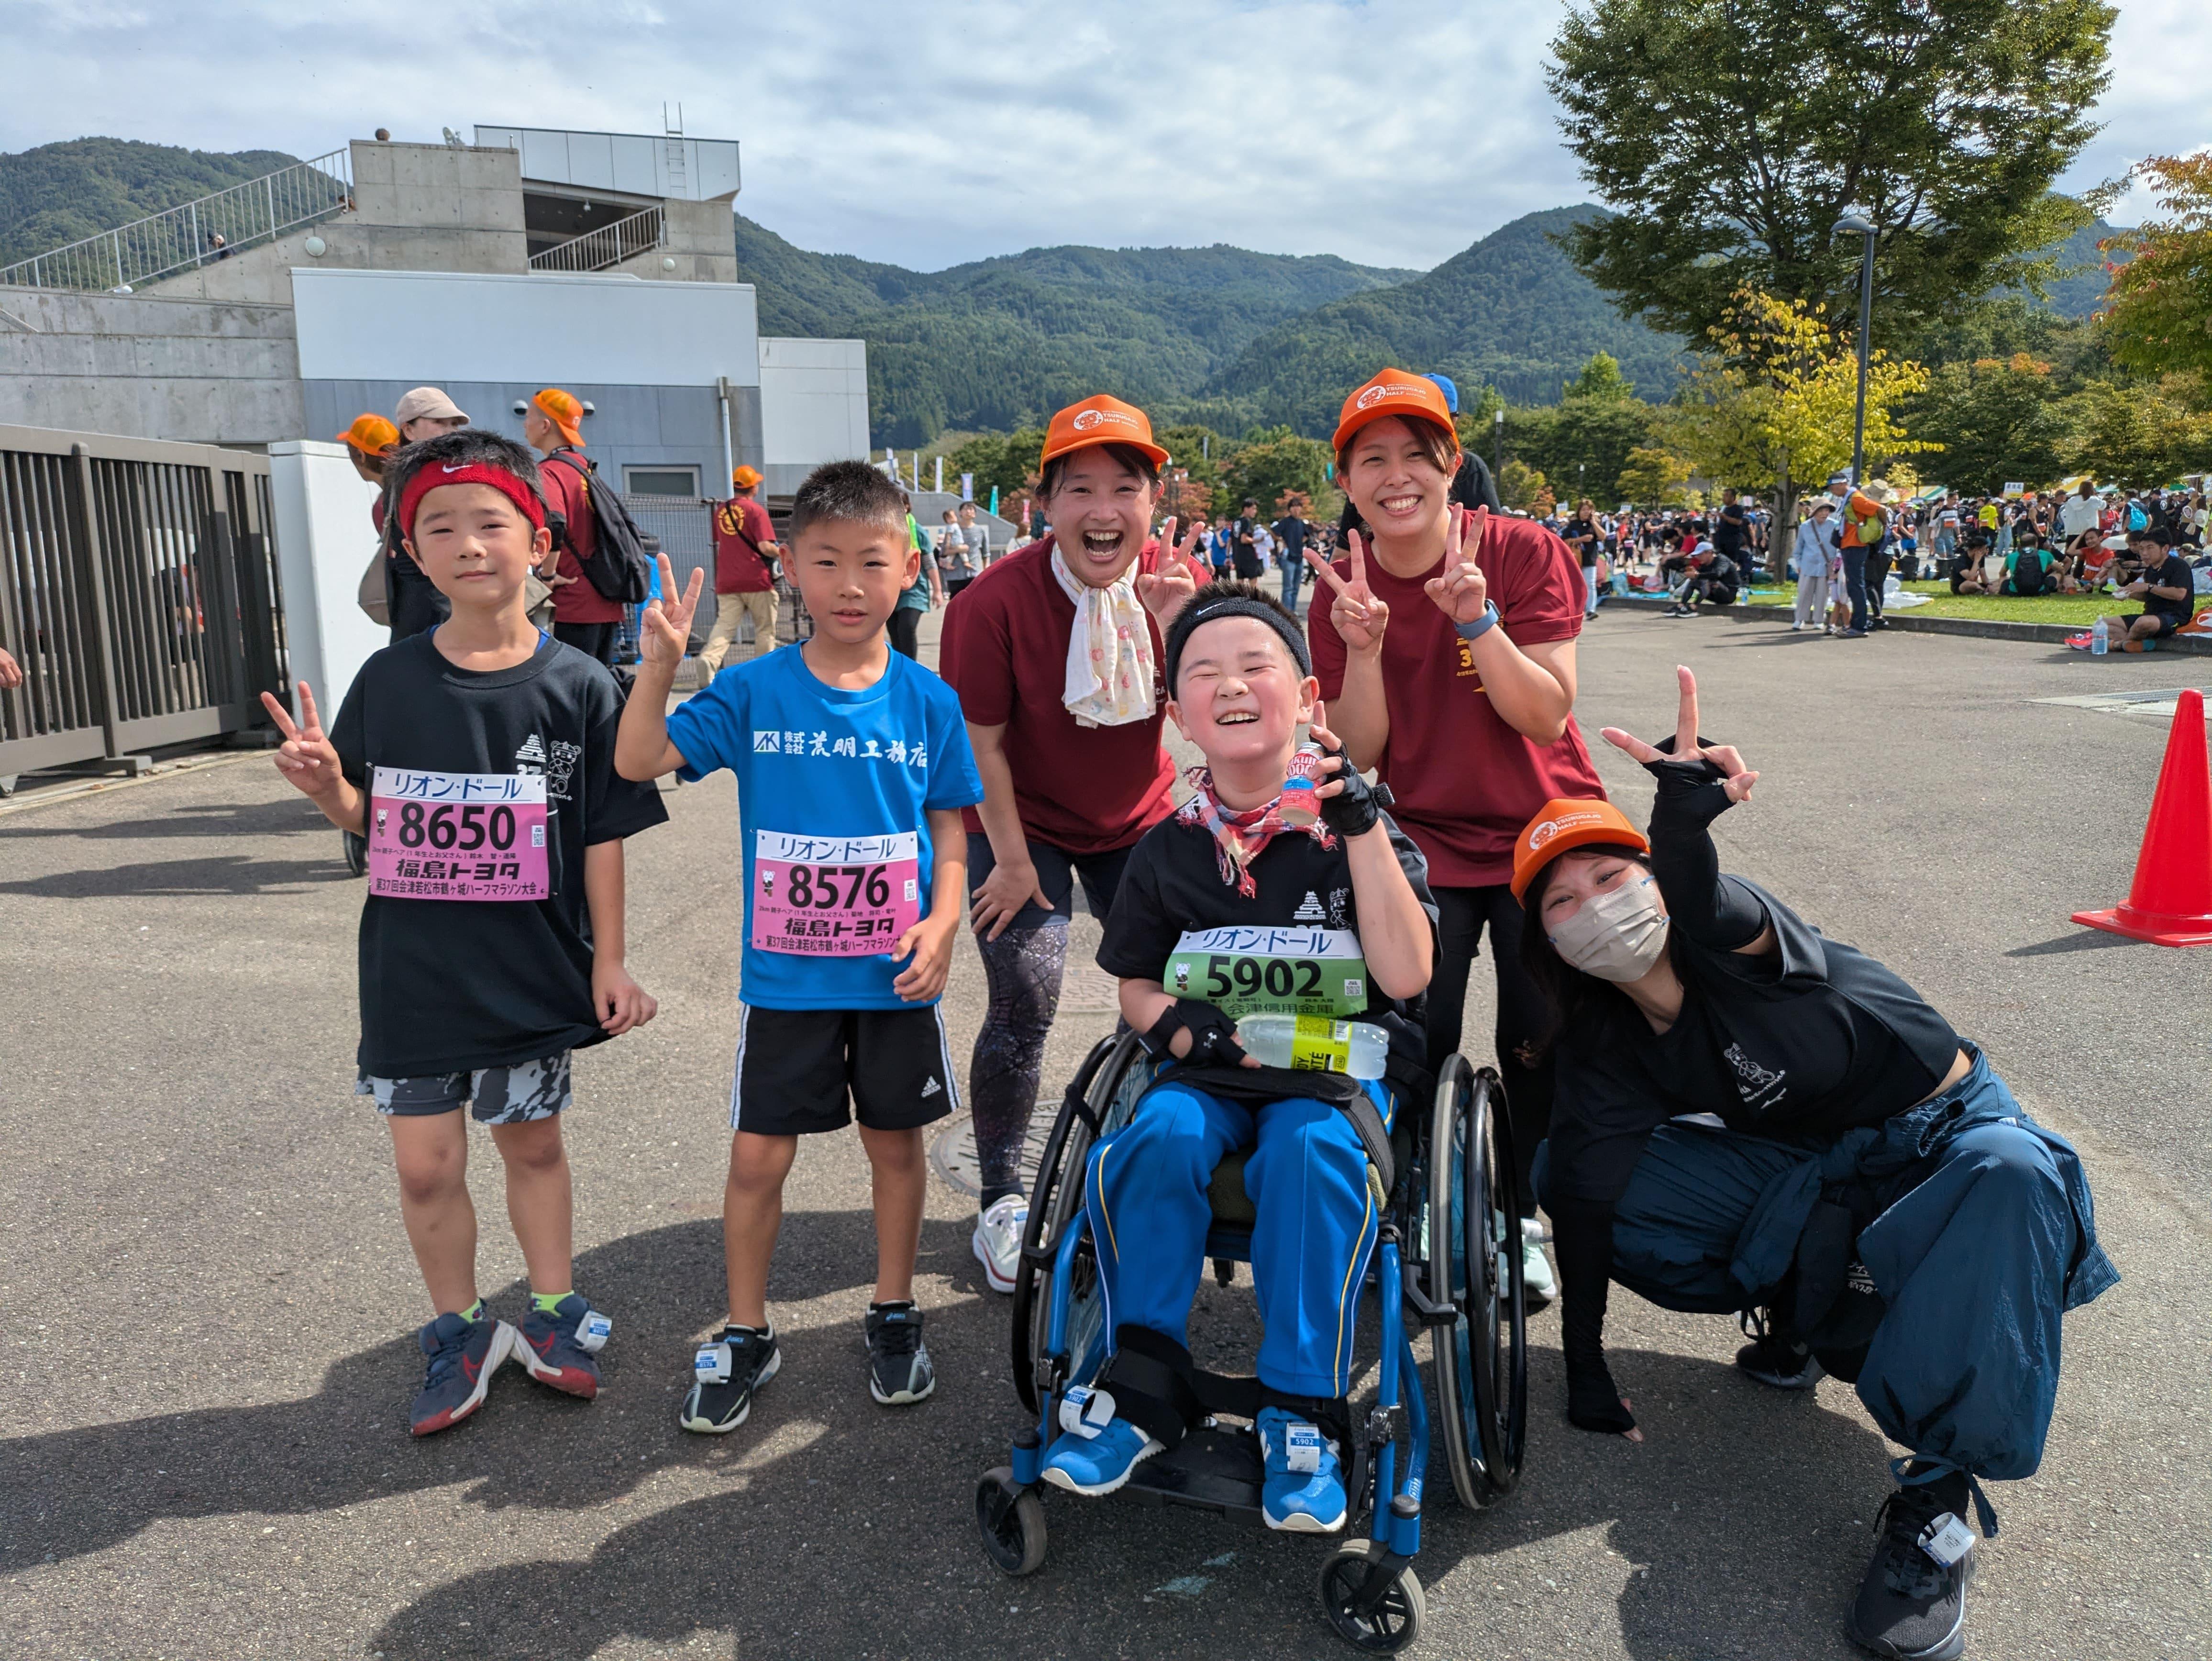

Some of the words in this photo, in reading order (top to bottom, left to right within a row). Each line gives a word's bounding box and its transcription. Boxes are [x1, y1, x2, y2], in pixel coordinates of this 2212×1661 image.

[395, 773, 523, 799] リオン・ドール
[399, 802, 516, 851] 8650
[781, 838, 896, 861] リオン・ドール
[396, 859, 520, 880] 福島トヨタ
[788, 864, 890, 909] 8576
[785, 918, 895, 937] 福島トヨタ
[766, 935, 901, 952] 第37回会津若松市鶴ヶ城ハーフマラソン
[1203, 929, 1332, 954] リオン・ドール
[1207, 955, 1324, 997] 5902
[1228, 1003, 1334, 1014] 会津信用金庫
